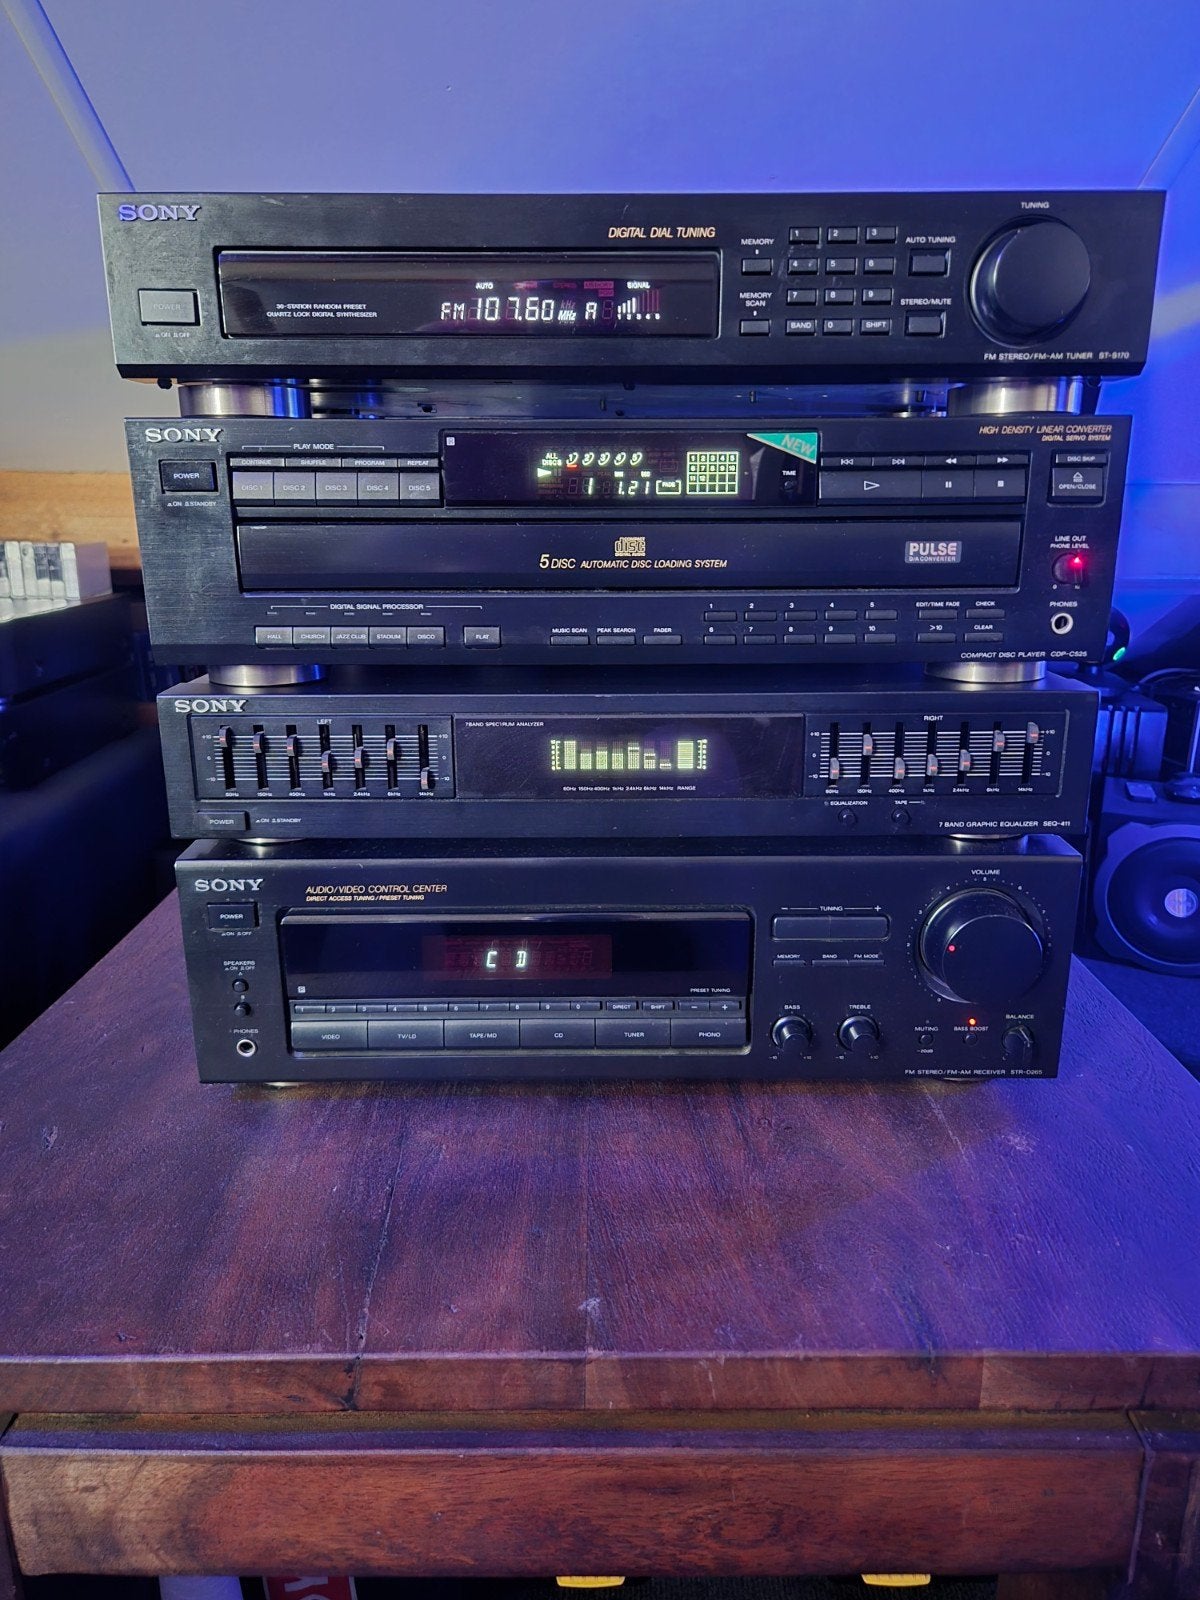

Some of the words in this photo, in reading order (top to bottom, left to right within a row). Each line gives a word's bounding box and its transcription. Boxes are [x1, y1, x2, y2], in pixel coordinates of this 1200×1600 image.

[118, 204, 200, 222] SONY
[608, 227, 646, 238] DIGITAL
[650, 227, 673, 238] DIAL
[677, 227, 716, 238] TUNING
[441, 302, 464, 320] FM
[475, 297, 555, 320] 107.60
[558, 310, 576, 320] MHz
[585, 302, 597, 320] A
[145, 428, 224, 443] SONY
[979, 426, 999, 435] HIGH
[1001, 425, 1034, 434] DENSITY
[1036, 425, 1064, 434] LINEAR
[1066, 425, 1112, 433] CONVERTER
[780, 434, 814, 454] NEW
[615, 537, 646, 553] disc
[908, 543, 957, 556] PULSE
[539, 554, 550, 568] 5
[550, 559, 576, 569] DISC
[580, 560, 630, 569] AUTOMATIC
[631, 560, 652, 568] DISC
[654, 560, 693, 568] LOADING
[694, 560, 727, 568] SYSTEM
[174, 700, 248, 713] SONY
[195, 878, 263, 892] SONY
[306, 885, 365, 894] AUDIO/VIDEO
[368, 885, 410, 893] CONTROL
[412, 885, 447, 893] CENTER
[486, 950, 497, 968] C
[516, 950, 526, 968] D
